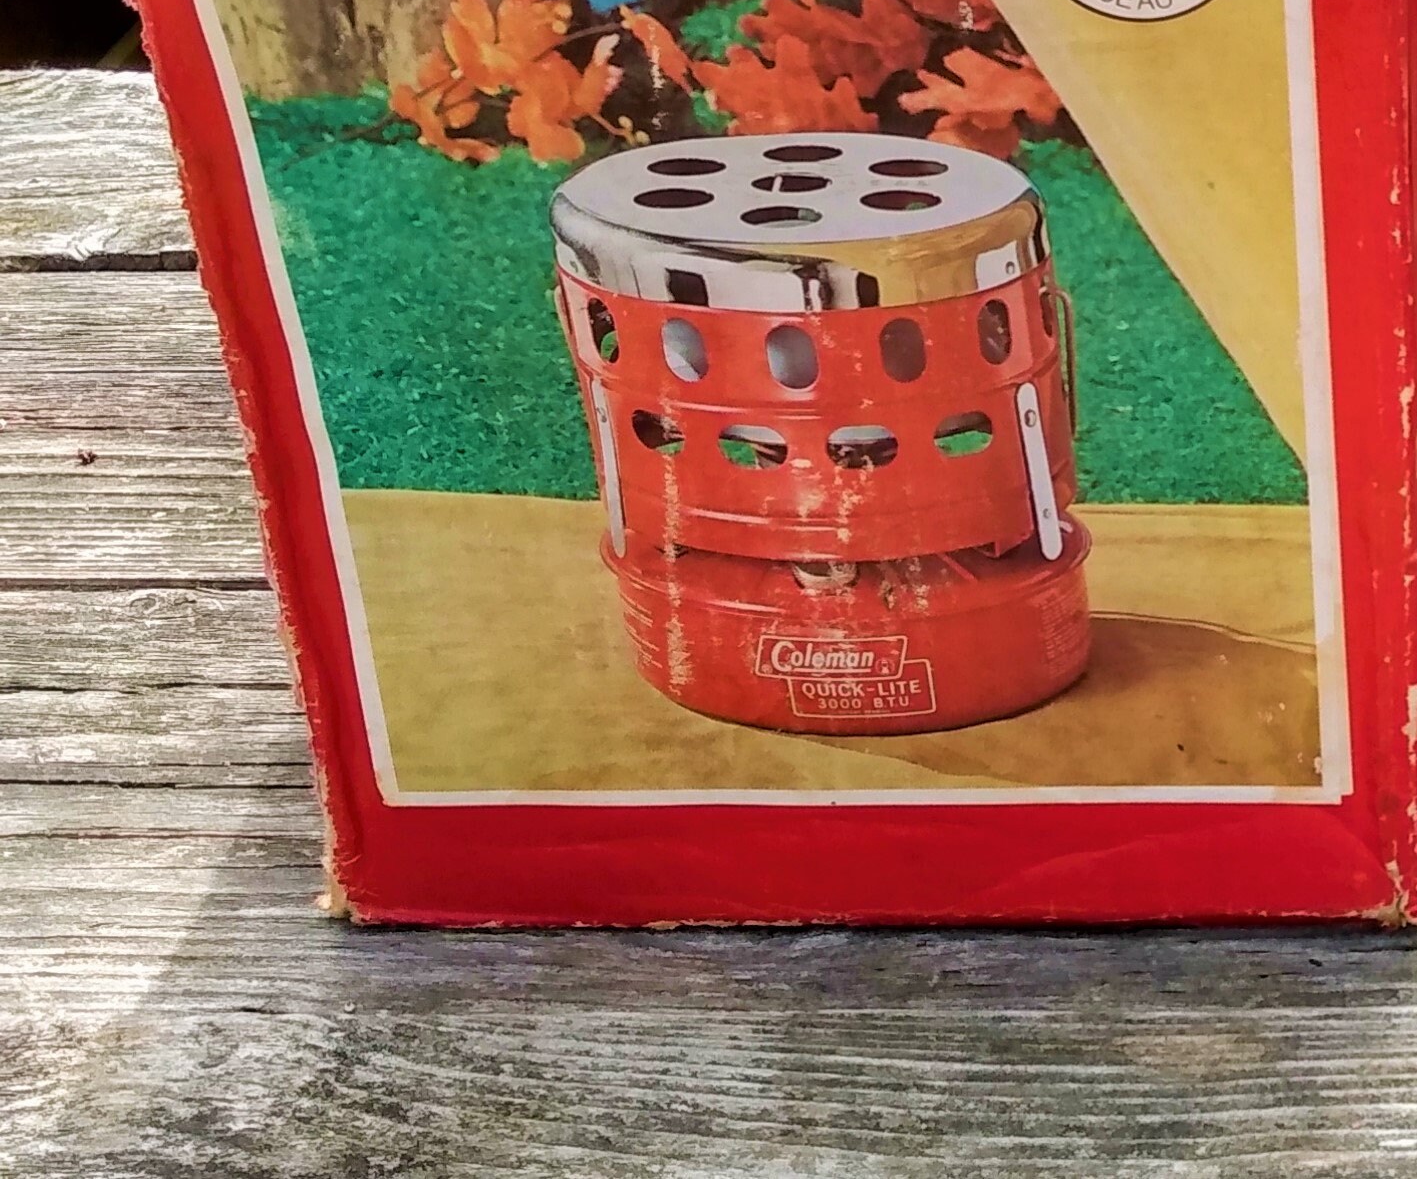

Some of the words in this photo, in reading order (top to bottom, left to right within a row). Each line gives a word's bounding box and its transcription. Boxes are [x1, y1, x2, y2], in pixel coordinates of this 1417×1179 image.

[771, 641, 875, 673] Coleman
[802, 679, 922, 700] QUICK-LITE
[818, 698, 862, 709] 3000
